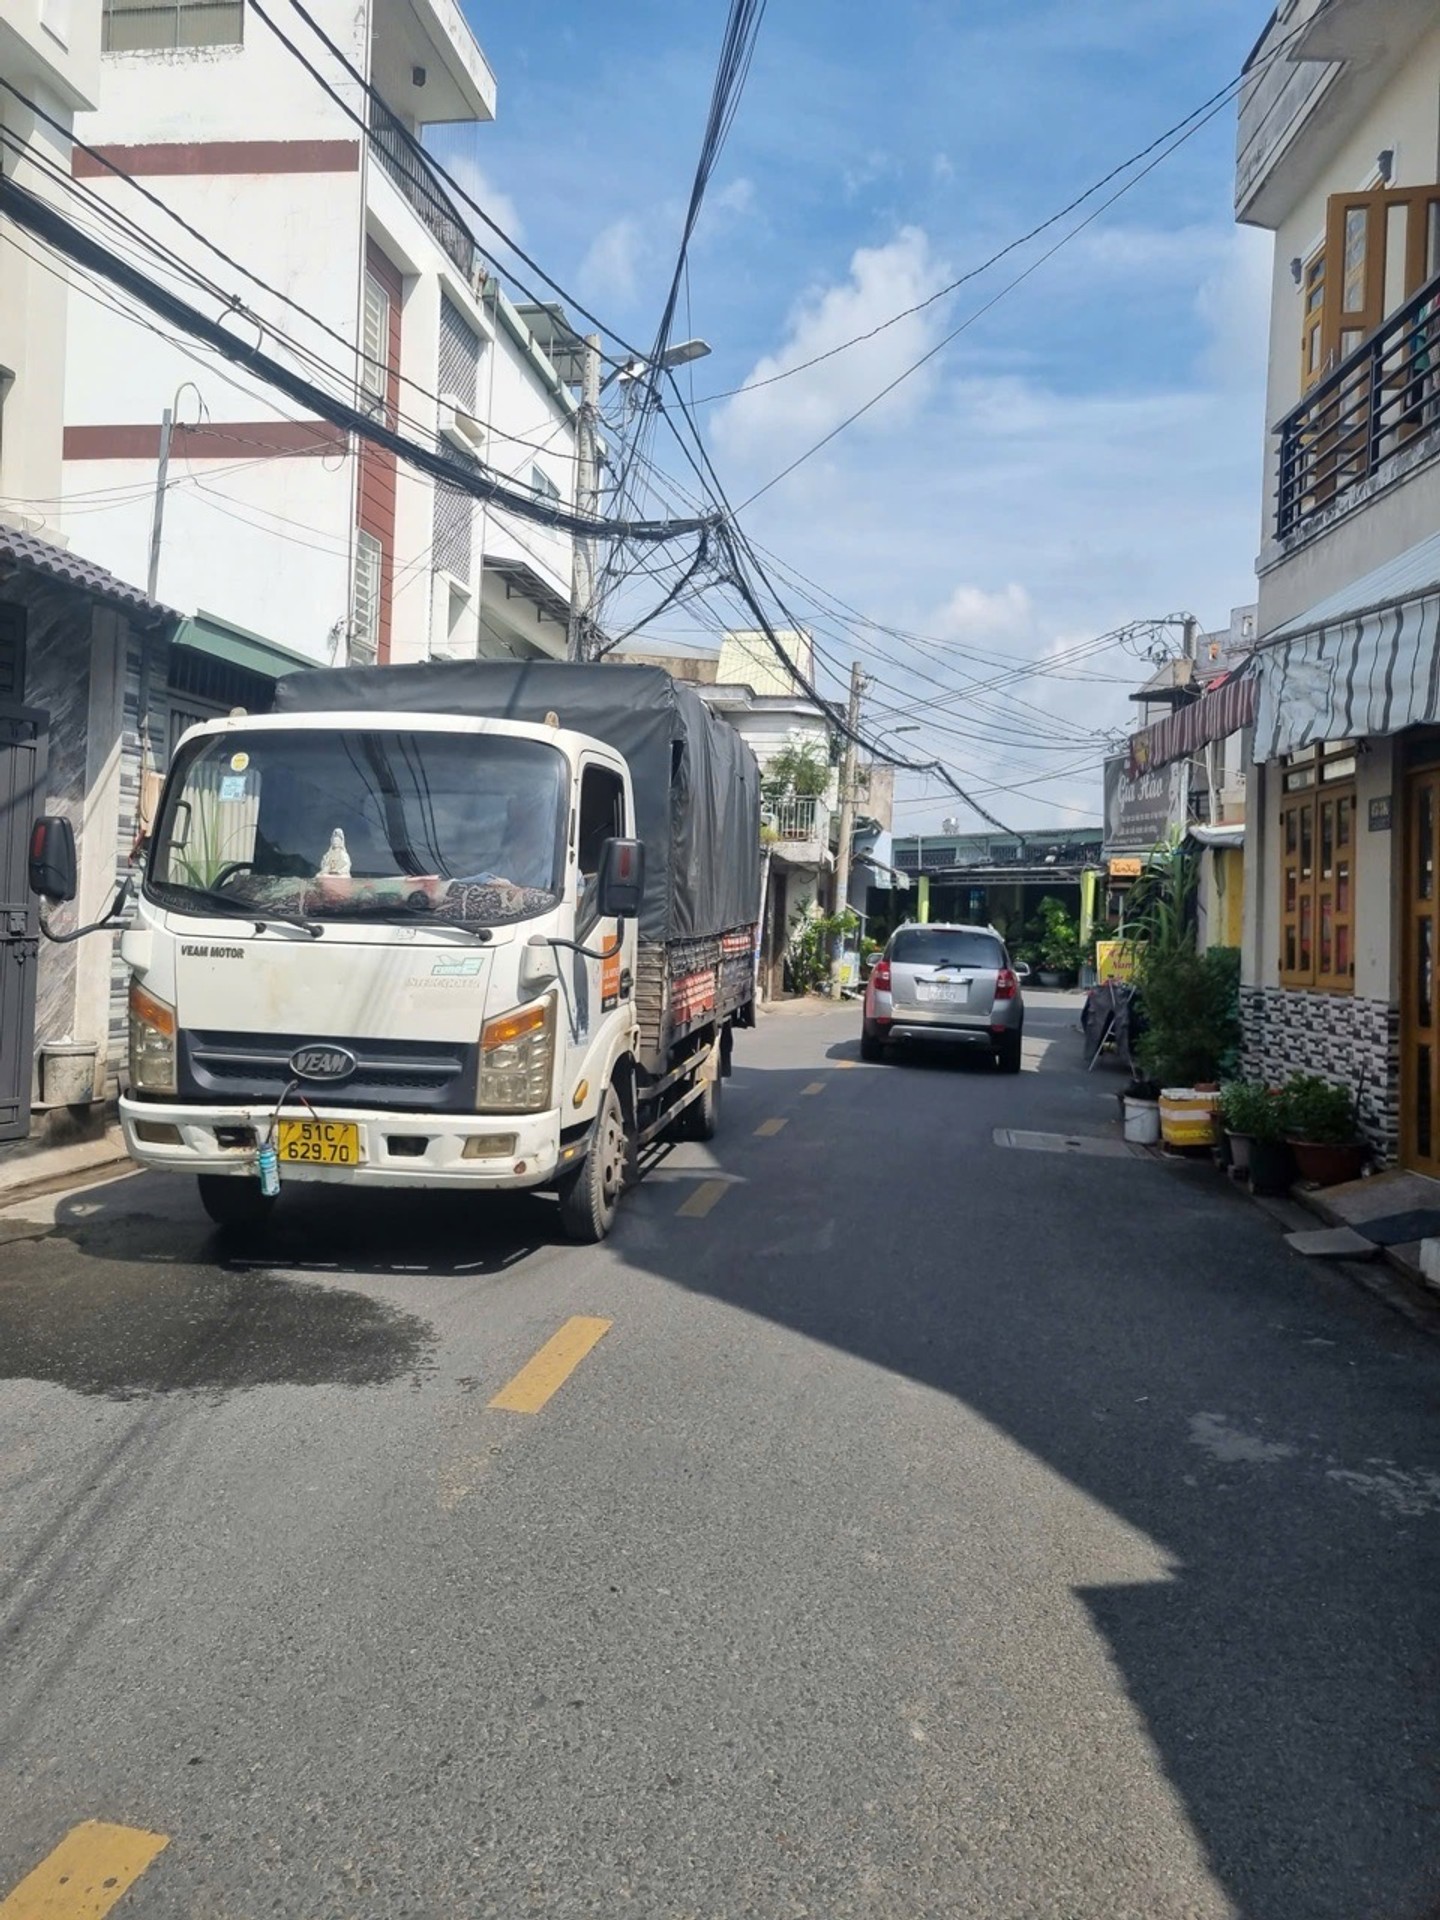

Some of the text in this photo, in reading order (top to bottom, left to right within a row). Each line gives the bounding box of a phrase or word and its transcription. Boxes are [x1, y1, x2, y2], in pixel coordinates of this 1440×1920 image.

[181, 945, 245, 959] VEAM MOTOR
[295, 1053, 347, 1073] VEAM
[302, 1123, 336, 1142] 51C
[288, 1141, 349, 1162] 629.70
